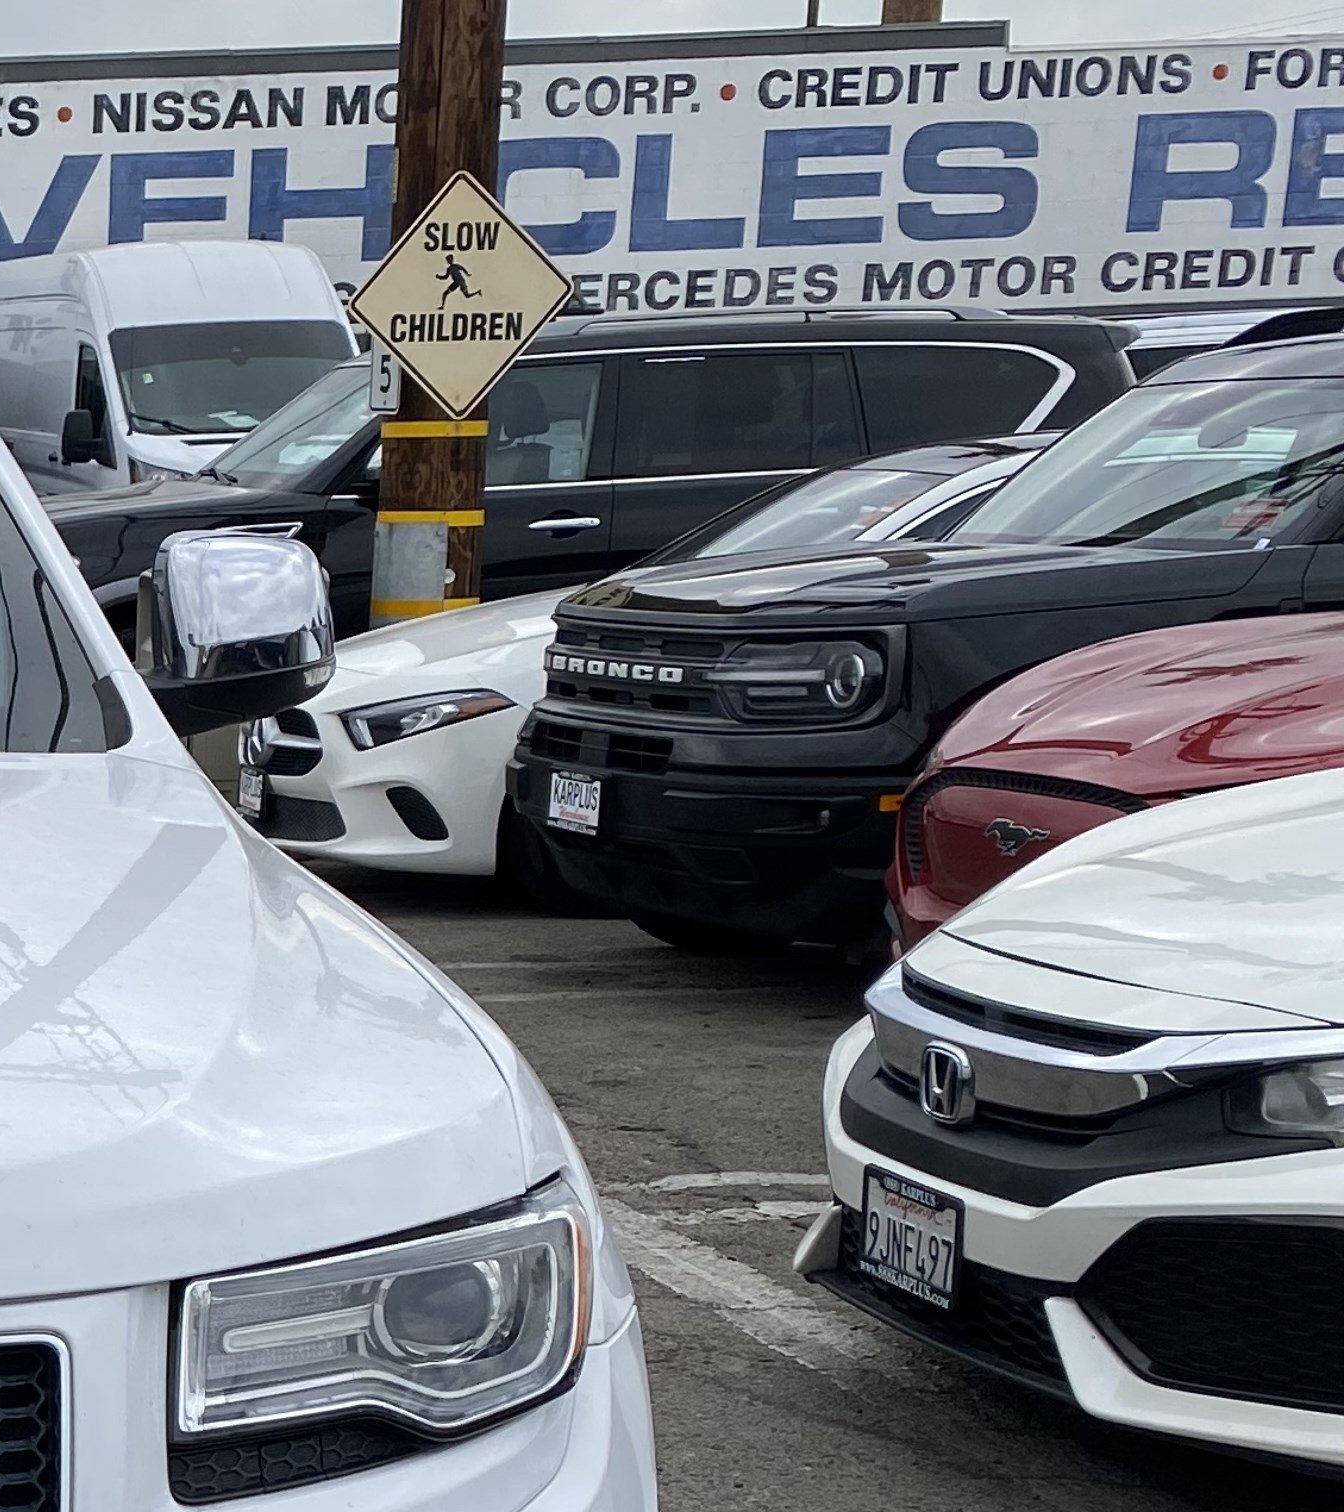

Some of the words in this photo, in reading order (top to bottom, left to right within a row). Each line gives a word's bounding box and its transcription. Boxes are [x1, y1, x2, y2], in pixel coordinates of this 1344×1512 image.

[91, 87, 305, 134] NISSAN
[325, 80, 522, 126] MOR
[545, 74, 701, 118] CORP.
[758, 63, 960, 110] CREDIT
[979, 53, 1193, 101] UNIONS
[1244, 48, 1344, 91] FOR
[423, 220, 501, 252] SLOW
[570, 264, 839, 312] ERCEDES
[862, 255, 1078, 303] MOTOR
[1101, 246, 1316, 294] CREDIT
[389, 311, 524, 343] CHILDREN
[379, 354, 392, 394] 5
[551, 654, 685, 684] BRONCO
[553, 778, 599, 811] KARPLUS
[868, 1210, 953, 1290] 9JNF497
